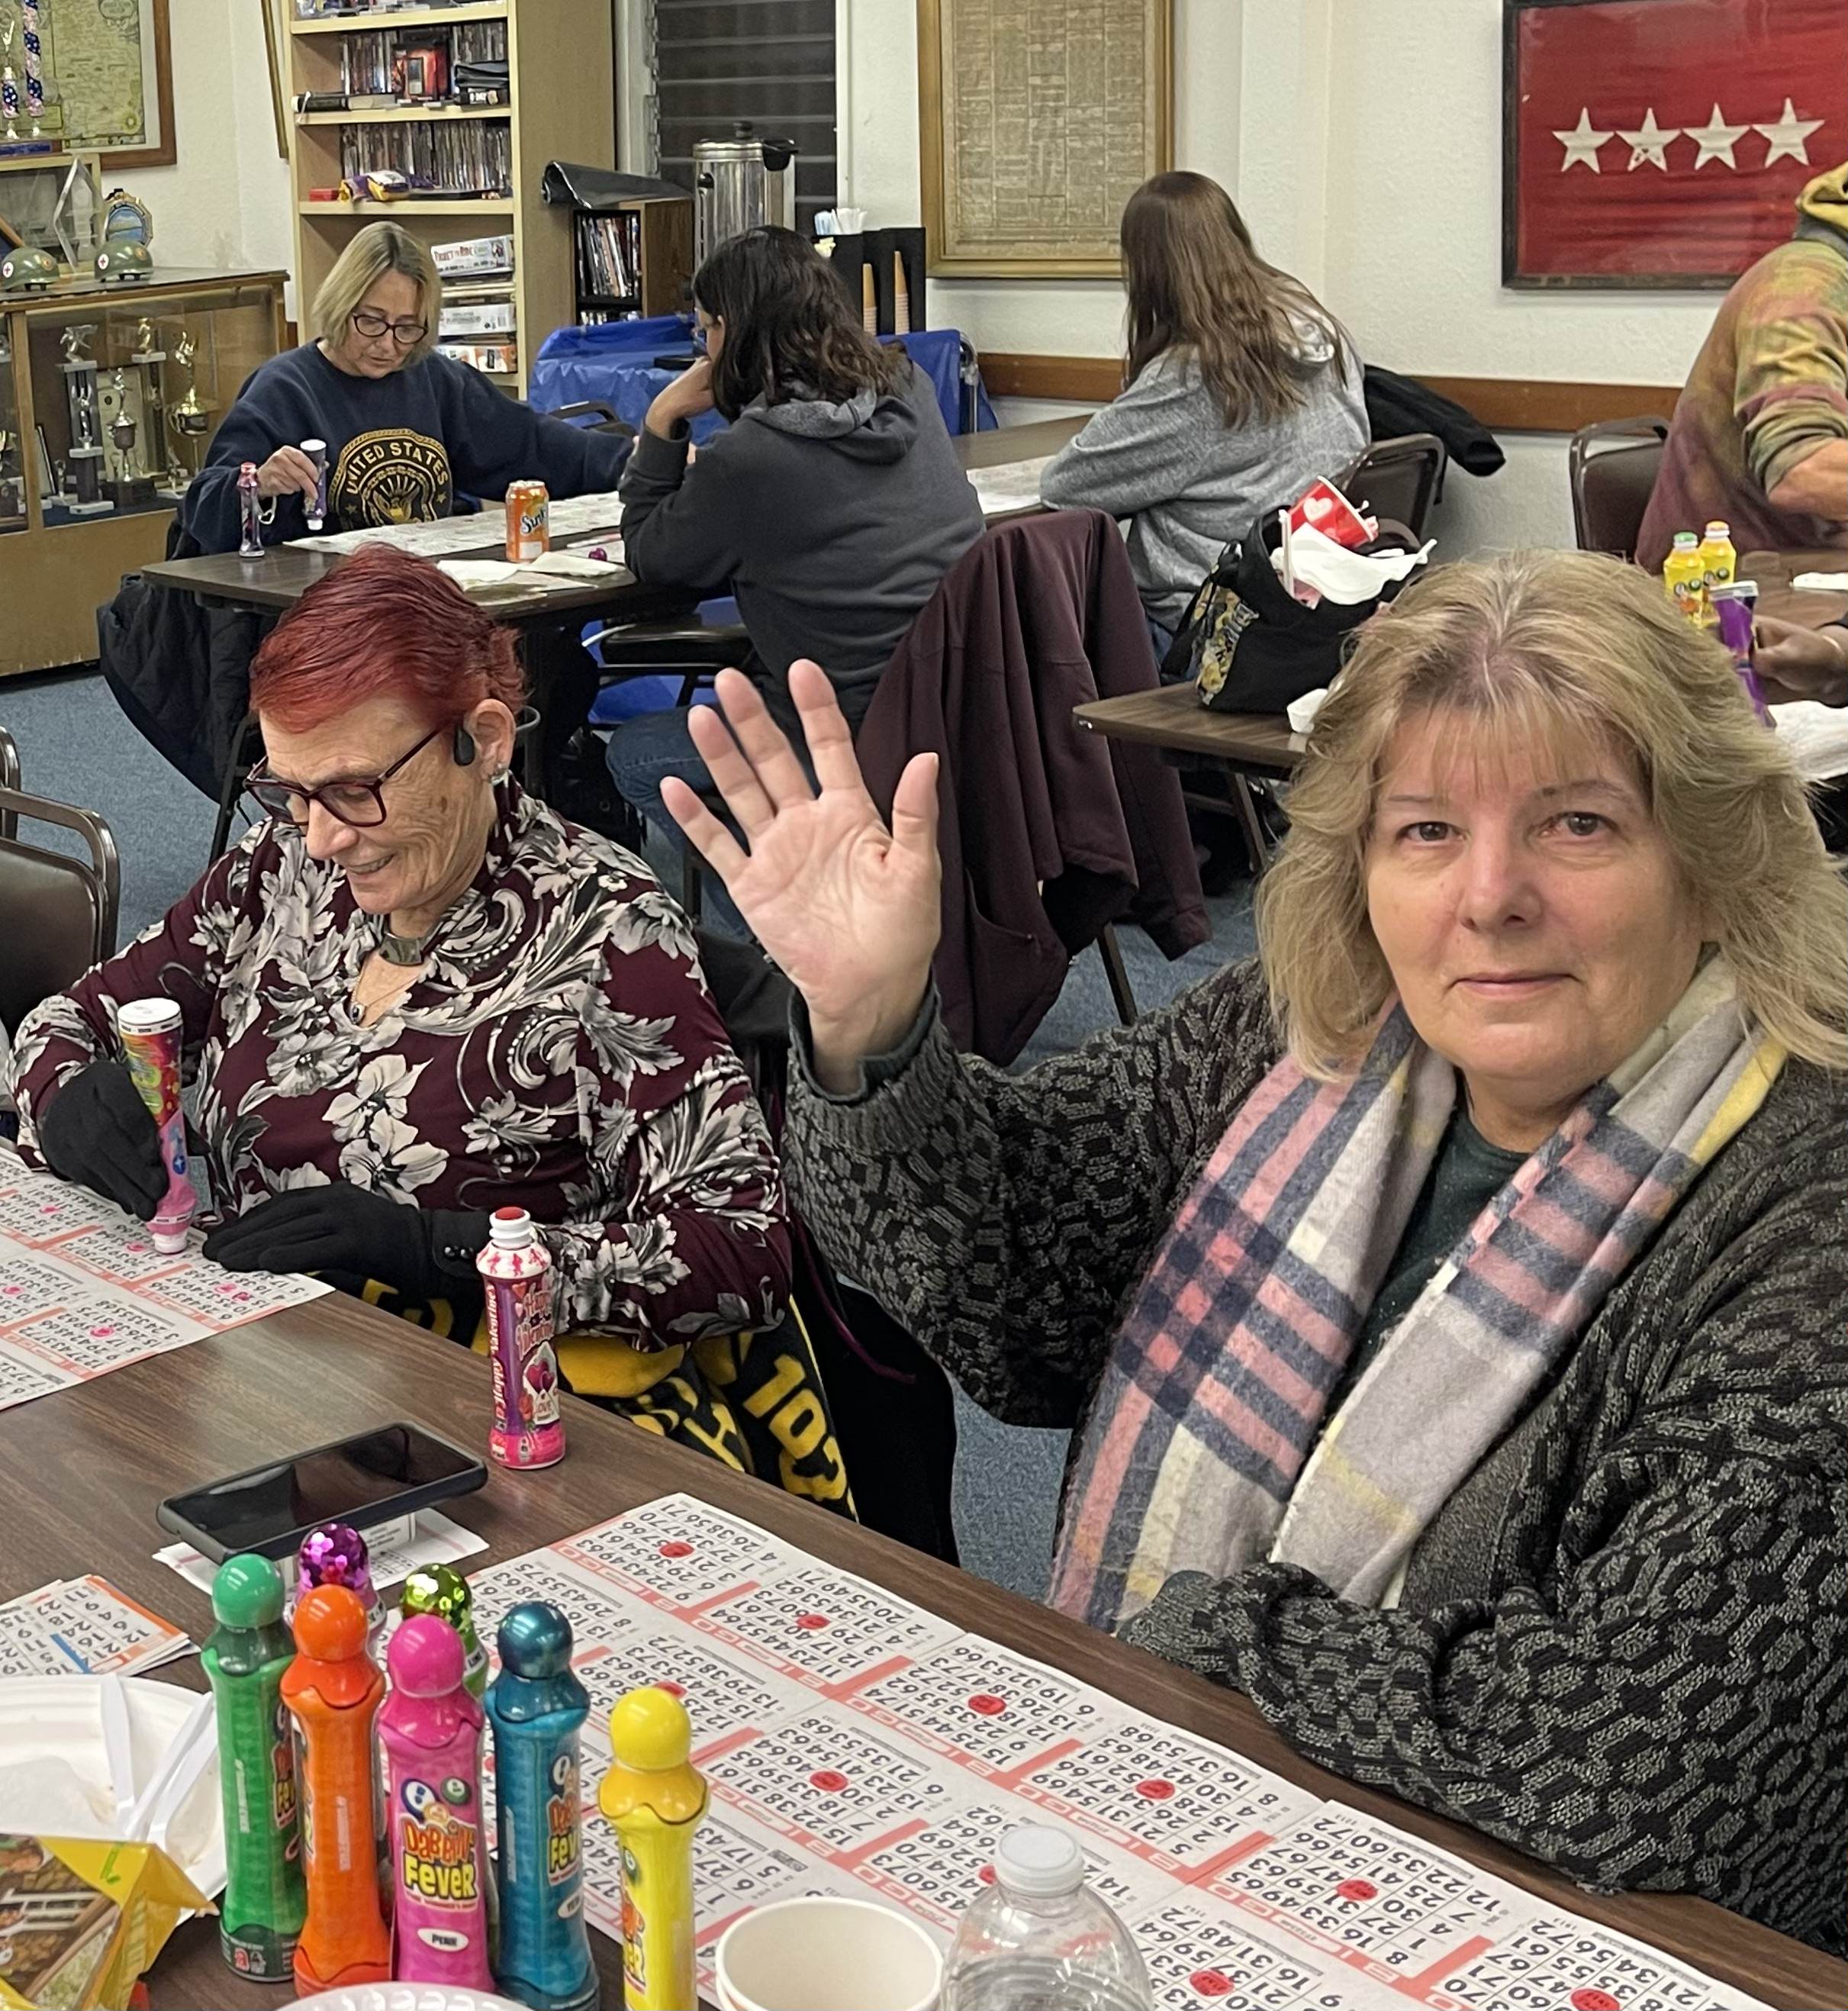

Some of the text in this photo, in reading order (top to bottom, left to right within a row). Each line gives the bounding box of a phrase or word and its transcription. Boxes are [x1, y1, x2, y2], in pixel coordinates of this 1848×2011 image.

[346, 442, 449, 495] UNITED STATES
[660, 1504, 777, 1561] 4 26 38 56 71
[0, 1614, 26, 1628] 15
[37, 1590, 88, 1616] 11 27
[49, 1602, 99, 1626] 9 18
[62, 1611, 111, 1638] 4 24
[493, 1572, 613, 1639] 13 16 48 63
[515, 1563, 631, 1628] 8 29 43 55 75
[797, 1571, 926, 1635] 2 20 35 49 71
[2, 1661, 72, 1675] 10 19
[18, 1629, 32, 1638] 9
[24, 1639, 47, 1652] 11
[40, 1652, 53, 1663] 5
[78, 1621, 127, 1648] 6 16
[94, 1629, 150, 1659] 12 21
[649, 1636, 783, 1710] 13 29 38 52 72
[909, 1667, 1055, 1742] 12 18 52 72
[929, 1658, 1077, 1730] 13 26 38 47 73
[954, 1647, 1095, 1716] 6 19 32 53 66
[864, 1689, 1011, 1765] 15 25 44 51 74
[887, 1677, 1027, 1751] 9 22 35 55 62
[730, 1751, 874, 1831] 7 18 33 59 65
[754, 1739, 897, 1819] 2 30 46 64
[778, 1729, 924, 1810] 13 23 41 54 63
[800, 1719, 944, 1794] 6 21 35 53 68
[1078, 1750, 1240, 1833] 15 28 52 61
[1098, 1738, 1257, 1816] 4 30 42 48 65
[1119, 1726, 1279, 1806] 8 16 37 53 68
[708, 1763, 852, 1845] 15 22 38 51 61
[1032, 1774, 1193, 1855] 5 21 31 54 69
[1058, 1761, 1214, 1843] 2 26 34 47 66
[1269, 1848, 1453, 1935] 4 30 47 67
[1293, 1832, 1476, 1923] 7 25 41 54 66
[1313, 1818, 1500, 1912] 12 22 35 60 72
[1226, 1871, 1409, 1964] 8 16 33 49 65
[1248, 1858, 1427, 1950] 1 27 31 59 63
[1531, 1920, 1574, 1945] 72
[1576, 1940, 1617, 1963] 56
[1615, 1959, 1659, 1984] 34
[1660, 1981, 1702, 2006] 21
